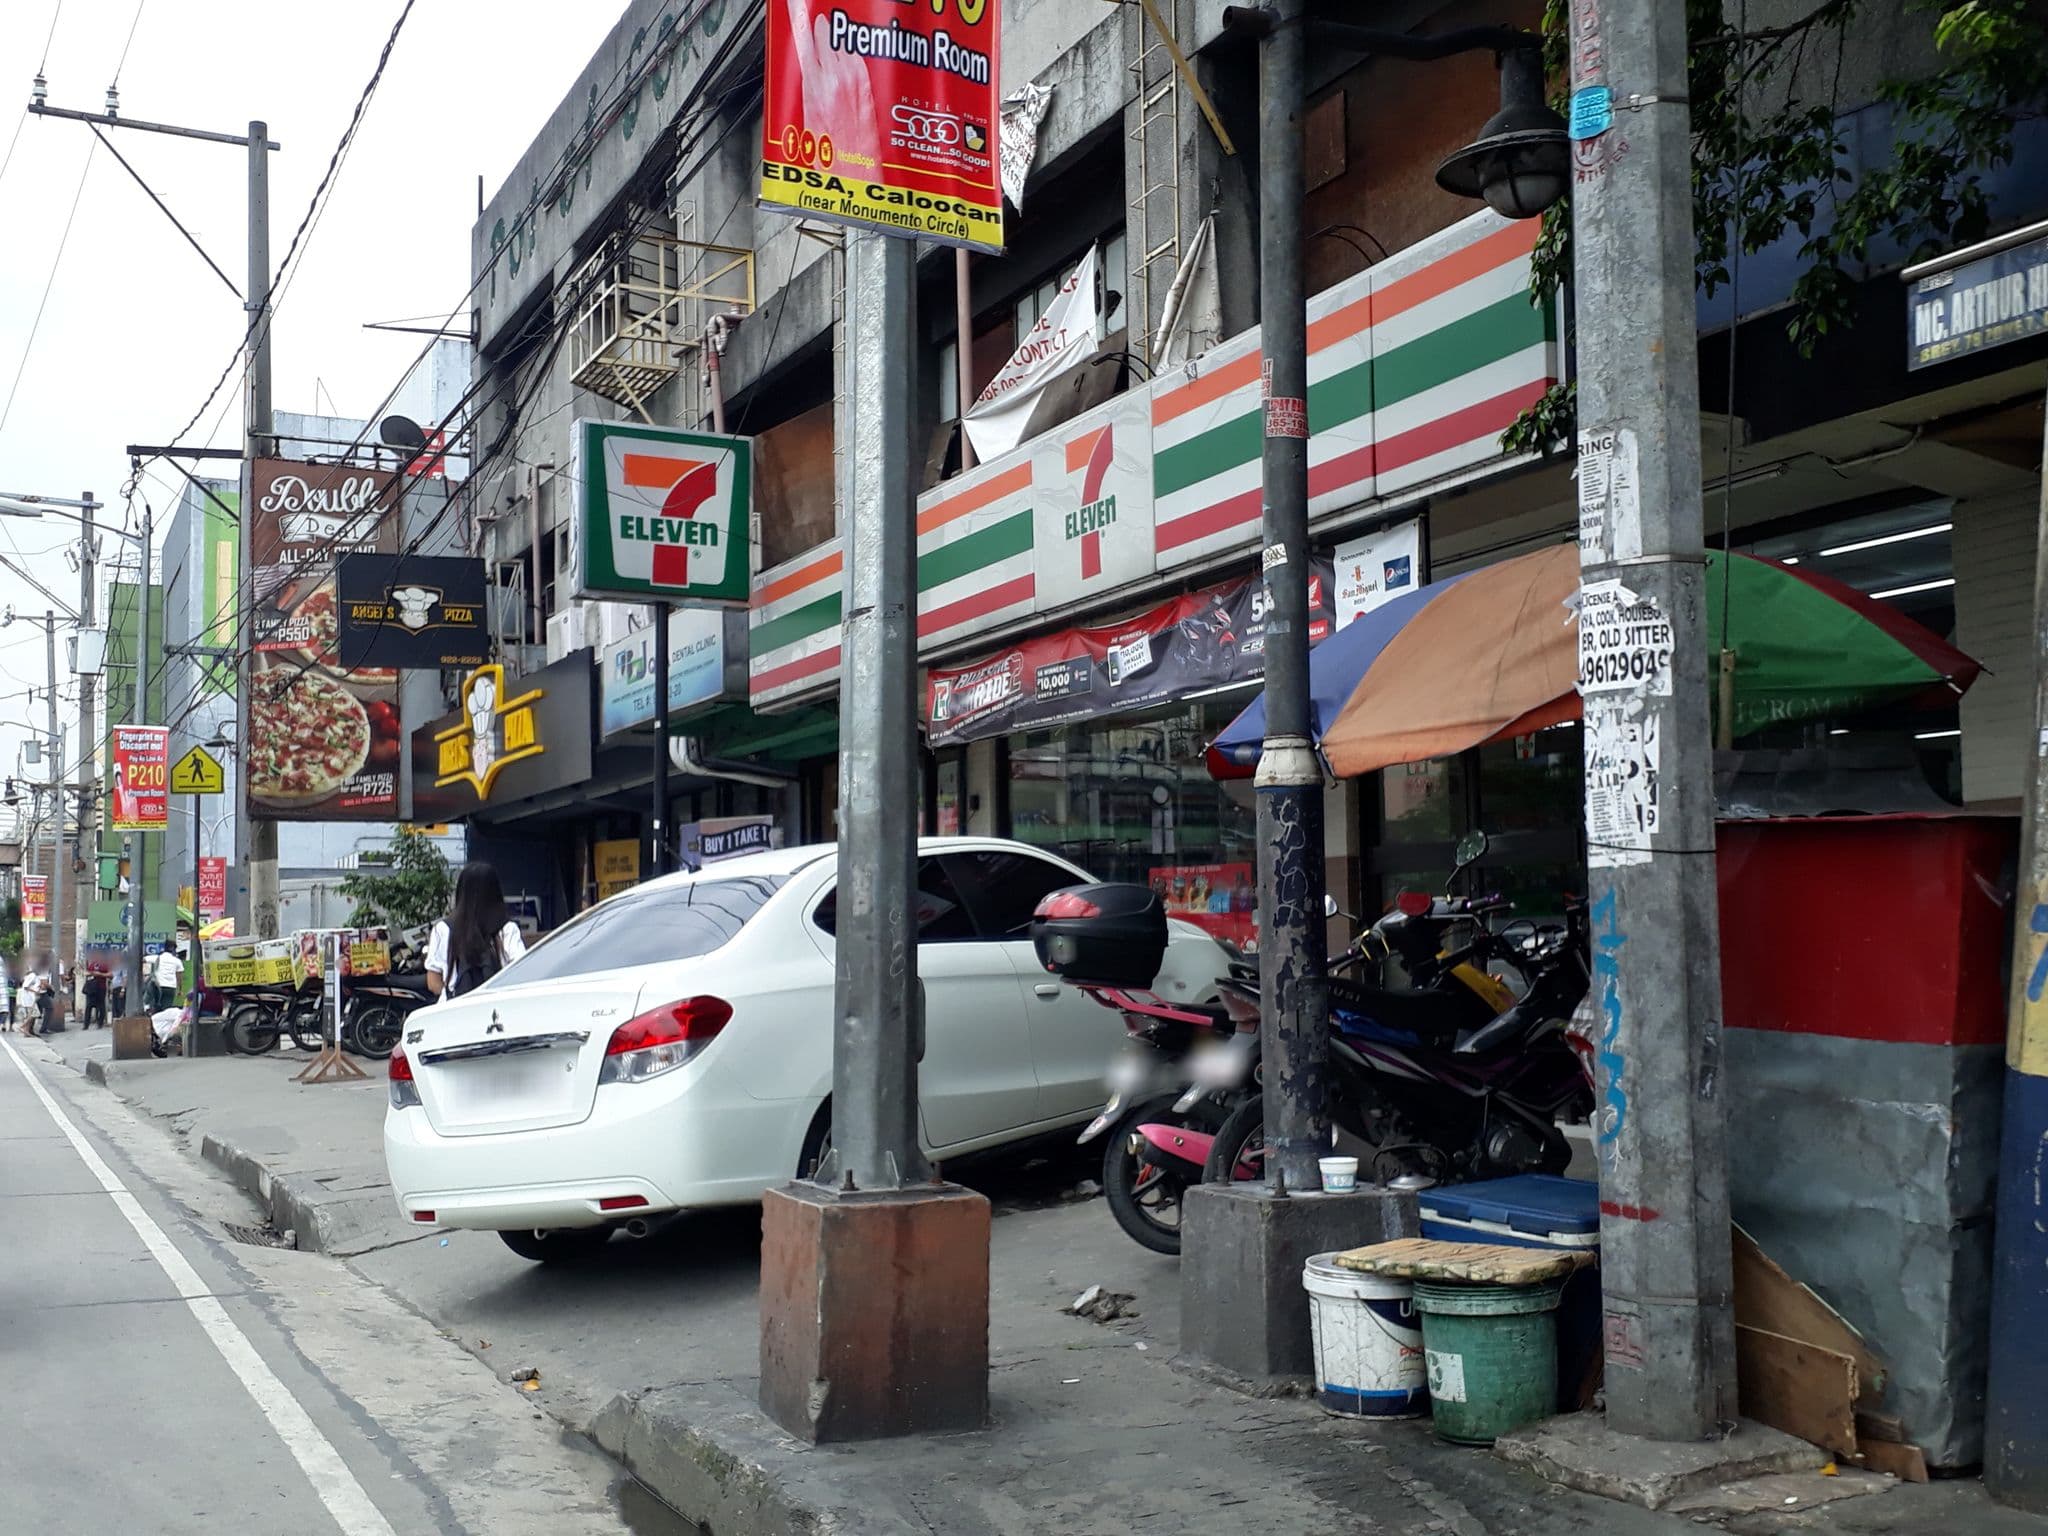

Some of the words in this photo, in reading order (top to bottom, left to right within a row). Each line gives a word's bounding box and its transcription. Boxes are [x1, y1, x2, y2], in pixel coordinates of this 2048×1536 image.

[830, 10, 928, 67] Premium
[933, 32, 989, 84] Room
[902, 96, 951, 112] HOTEL
[891, 104, 960, 145] SOGO
[891, 137, 905, 147] SO
[963, 151, 990, 168] GOOD!
[763, 162, 855, 199] EDSA,
[866, 184, 1001, 224] Caloocan
[798, 190, 835, 211] (near
[839, 198, 922, 228] Monumento
[927, 215, 969, 240] Circle)
[1950, 272, 2025, 336] ARTHUR
[260, 475, 390, 513] Double
[306, 516, 358, 540] Deal
[279, 548, 329, 565] ALL-DAY
[1342, 588, 1356, 599] San
[444, 608, 473, 622] PIZZA
[278, 627, 310, 642] P550
[1600, 628, 1621, 649] OLD
[1625, 624, 1670, 646] SITTER
[673, 645, 695, 664] DENTAL
[695, 634, 716, 653] CLINIC
[128, 764, 164, 787] P210
[363, 781, 393, 797] P725
[704, 836, 724, 854] BUY
[727, 833, 733, 849] 1
[734, 826, 760, 847] TAKE
[762, 825, 768, 841] 1
[199, 880, 223, 889] SALE
